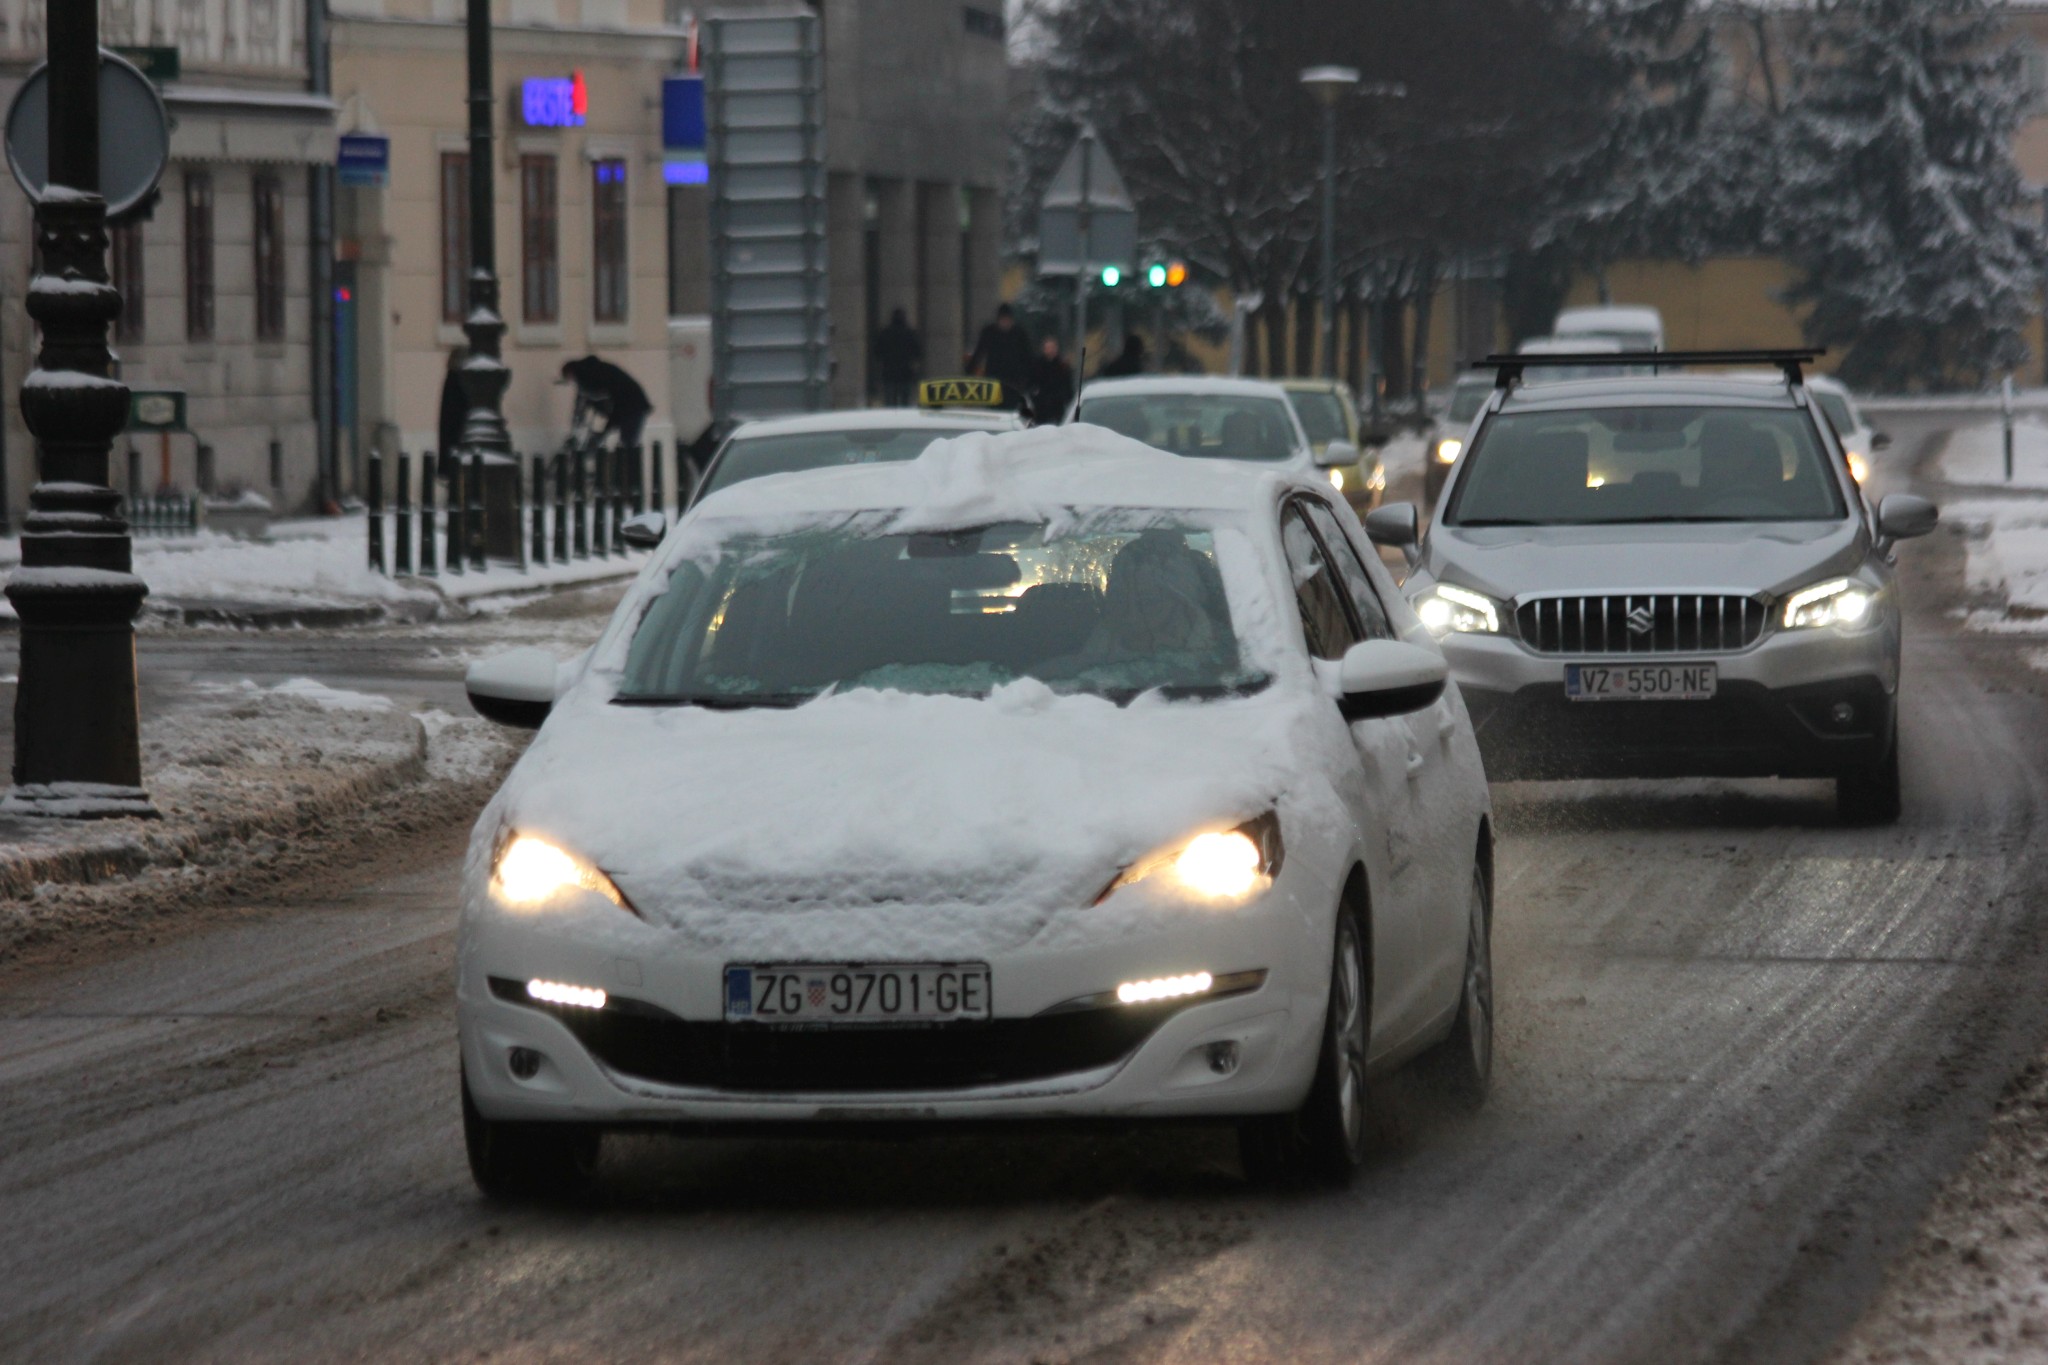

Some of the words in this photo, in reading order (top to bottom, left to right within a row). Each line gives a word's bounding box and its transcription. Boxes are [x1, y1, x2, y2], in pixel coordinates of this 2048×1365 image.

[931, 382, 988, 401] TAXI
[1582, 670, 1610, 693] VZ
[756, 974, 801, 1014] ZG
